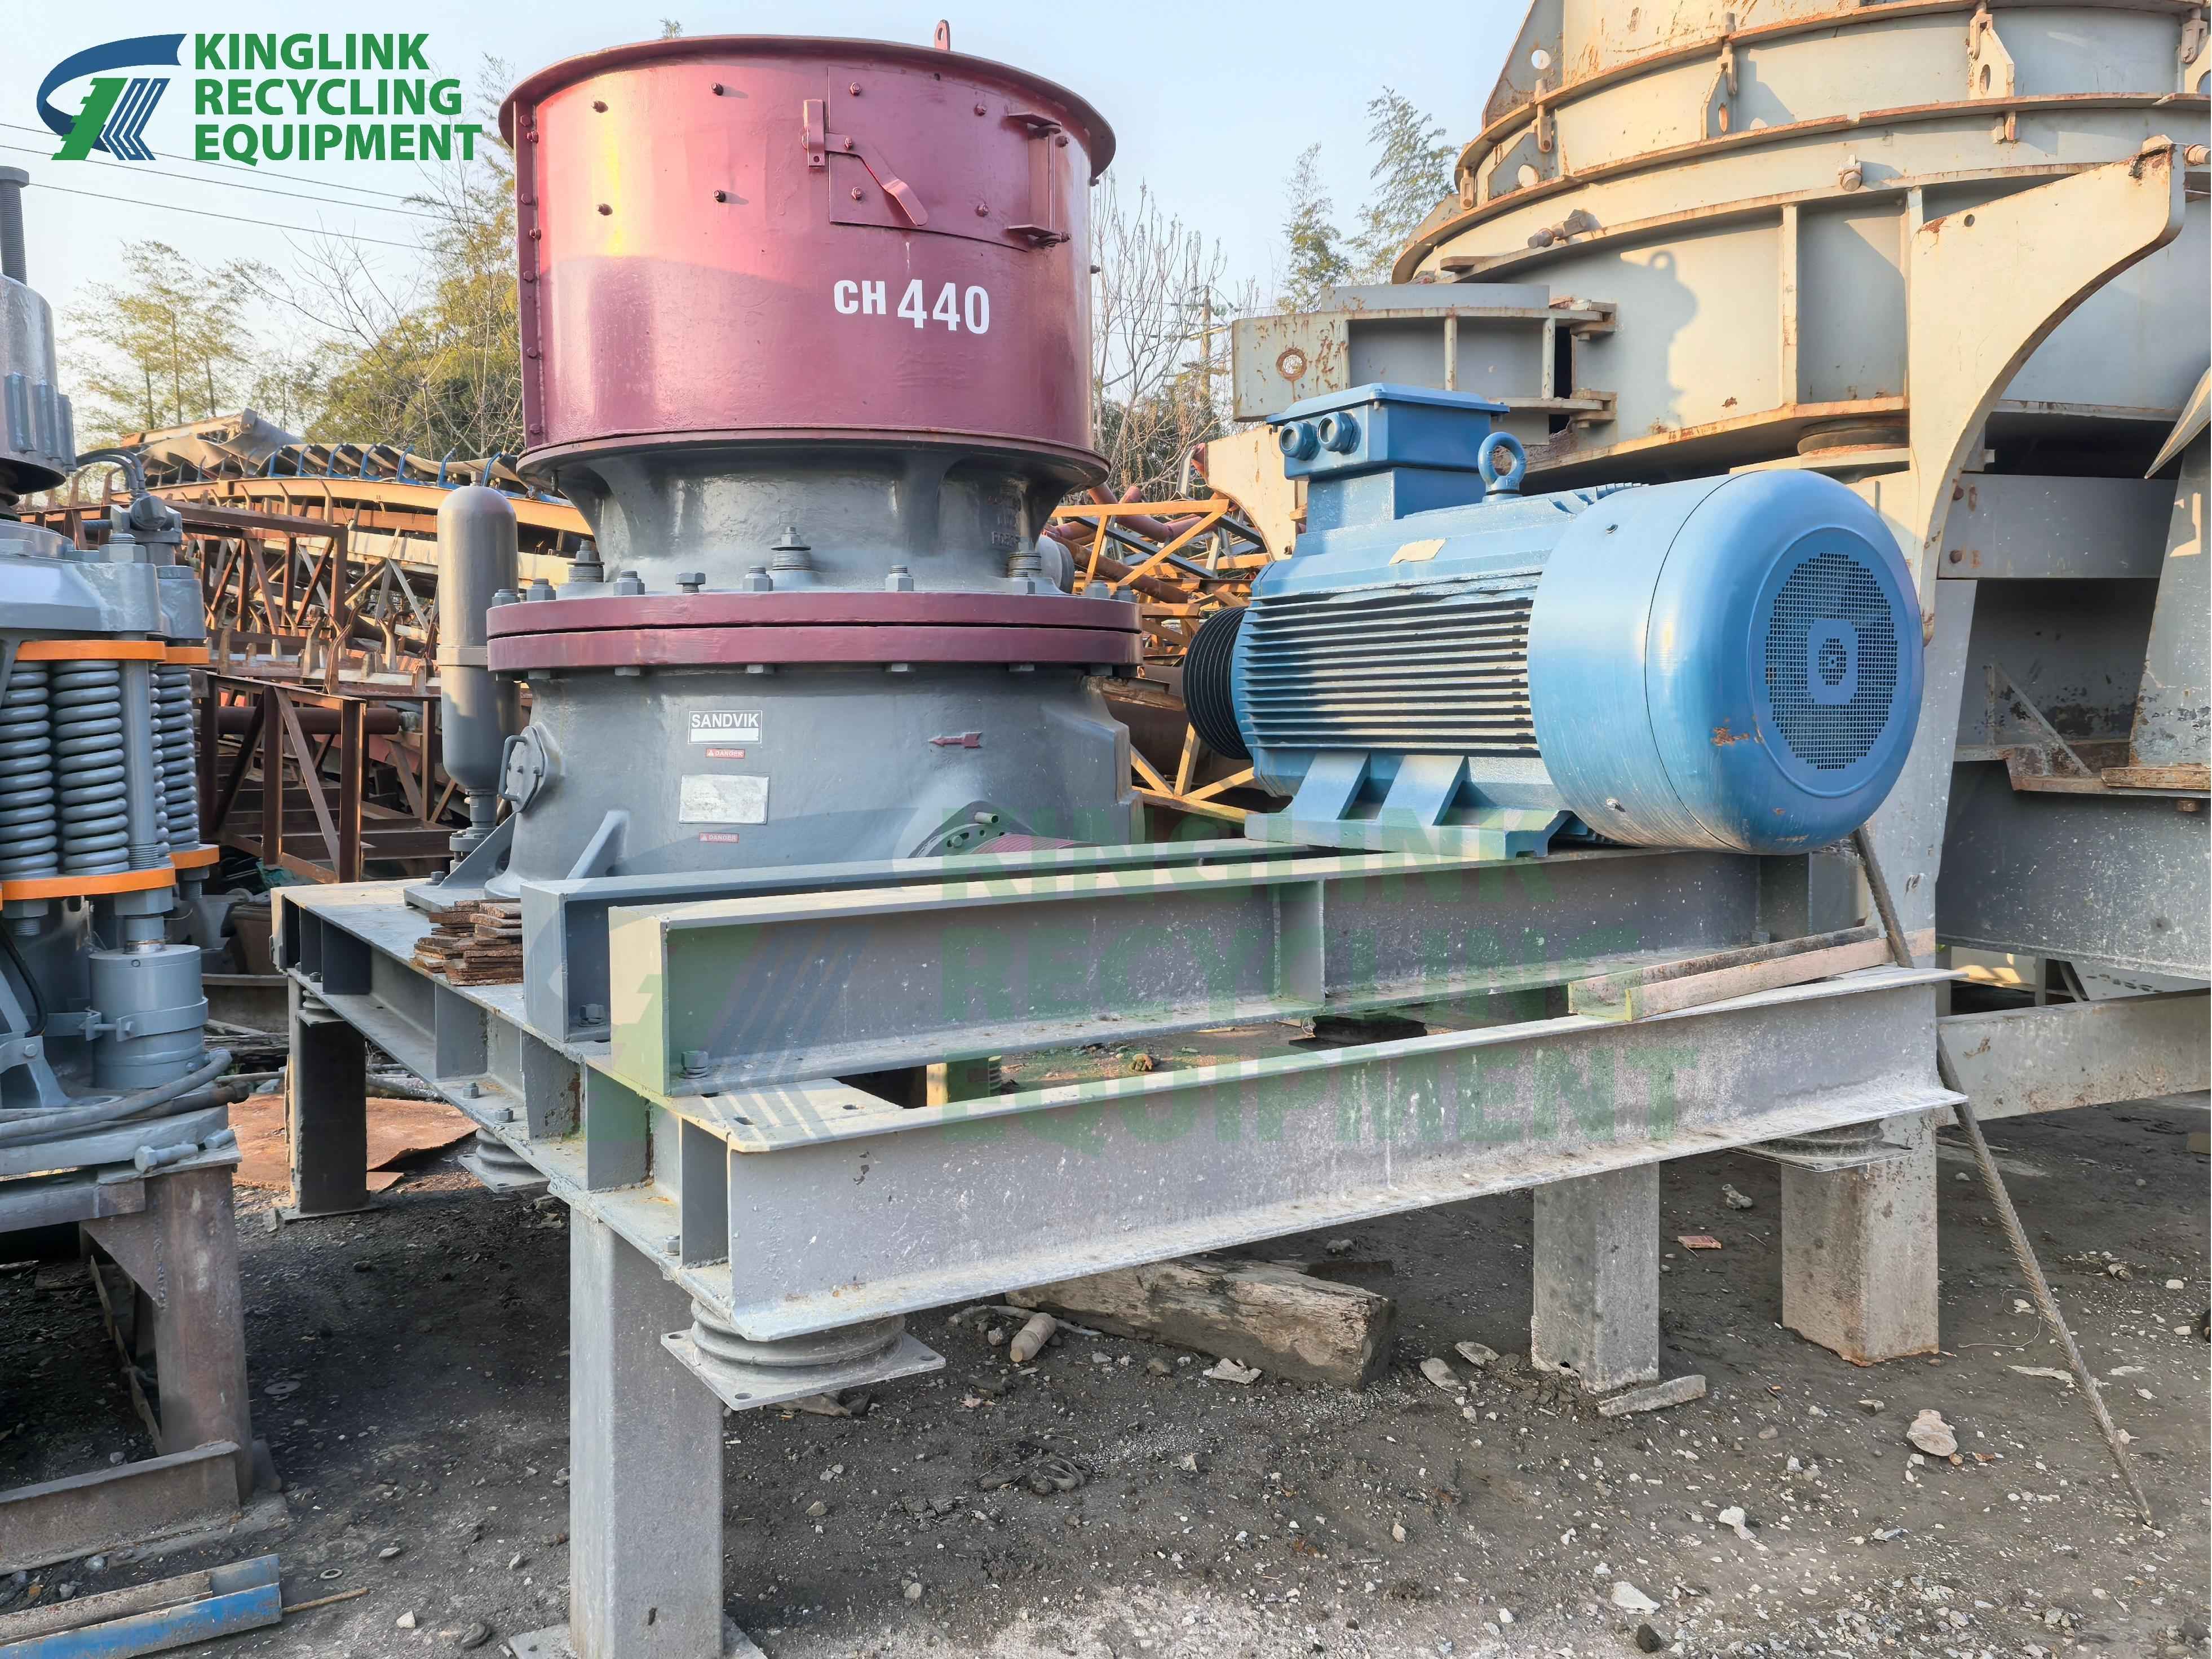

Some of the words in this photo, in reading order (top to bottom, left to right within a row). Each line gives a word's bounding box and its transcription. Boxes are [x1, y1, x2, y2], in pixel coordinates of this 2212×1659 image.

[834, 280, 887, 315] CH
[897, 279, 990, 334] 440
[691, 713, 759, 728] SANDVIK
